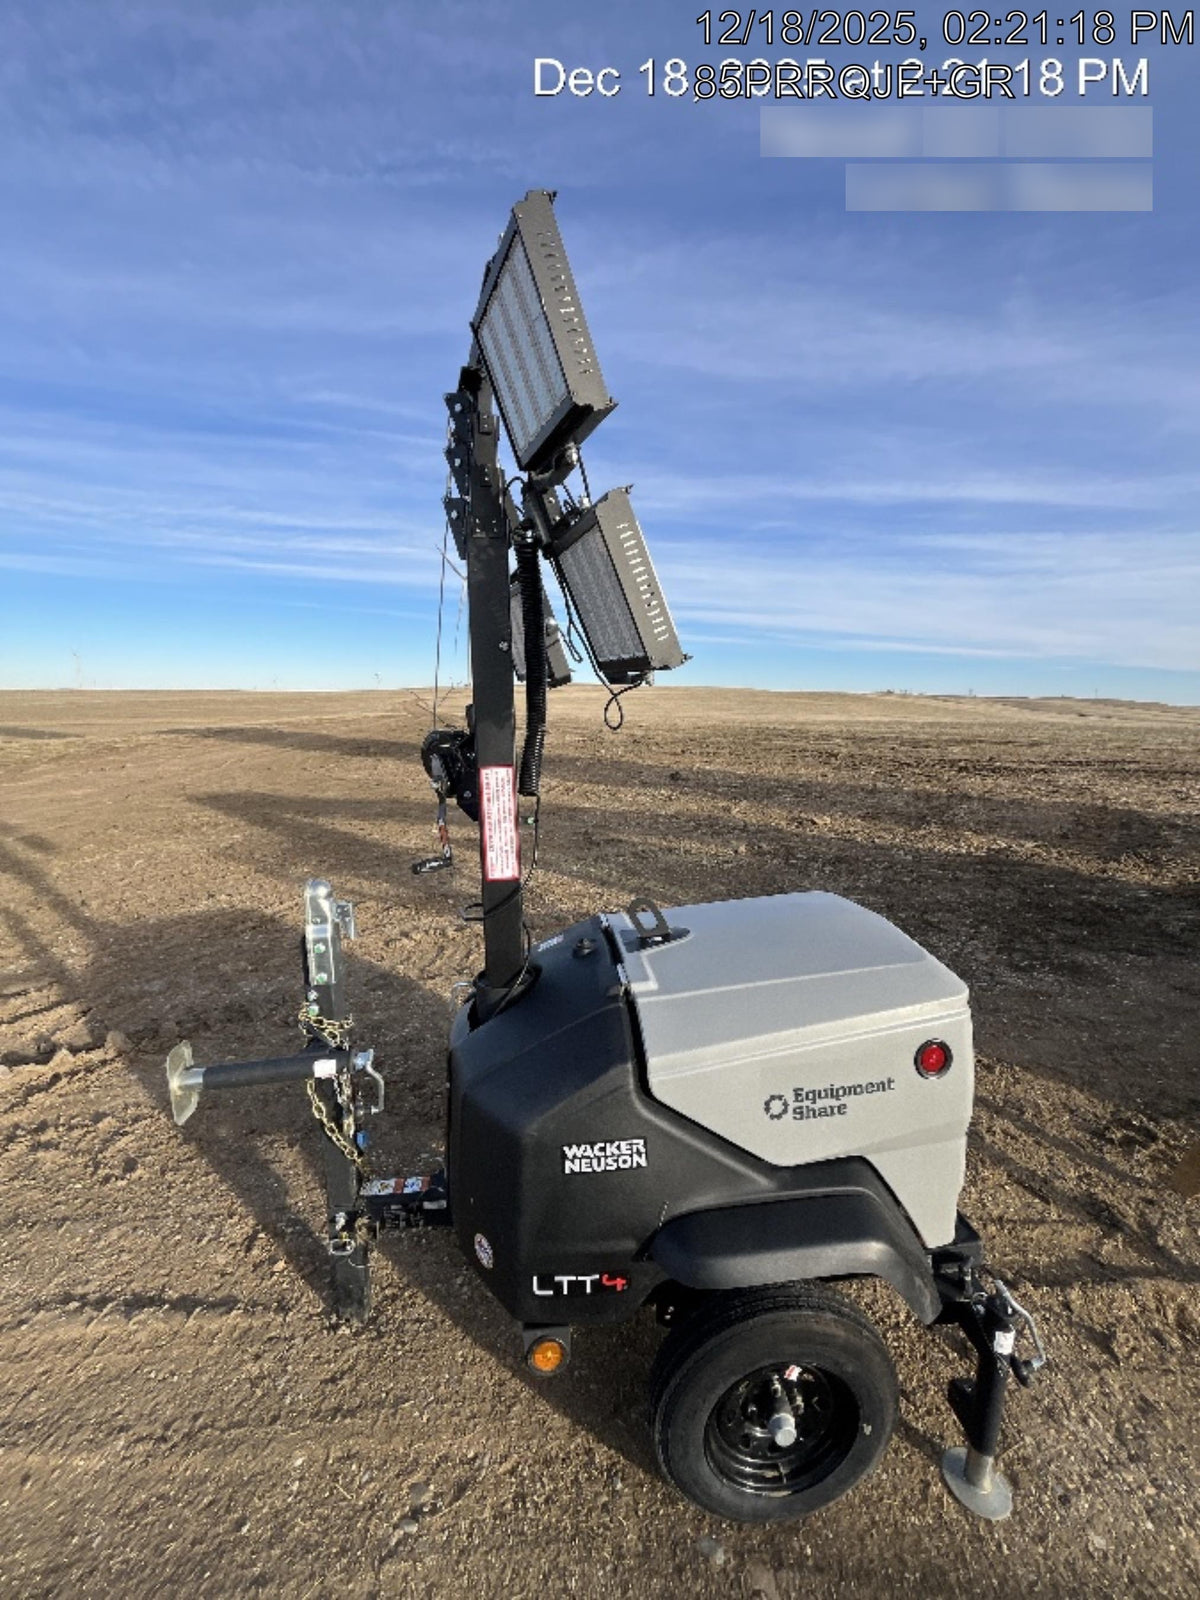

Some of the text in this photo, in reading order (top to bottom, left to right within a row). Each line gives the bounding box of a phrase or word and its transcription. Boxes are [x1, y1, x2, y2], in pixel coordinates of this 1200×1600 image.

[792, 1077, 895, 1104] Equipment
[792, 1103, 848, 1121] Share
[563, 1138, 646, 1160] WACKER
[564, 1153, 648, 1174] NEUSON
[532, 1271, 627, 1296] LTT4
